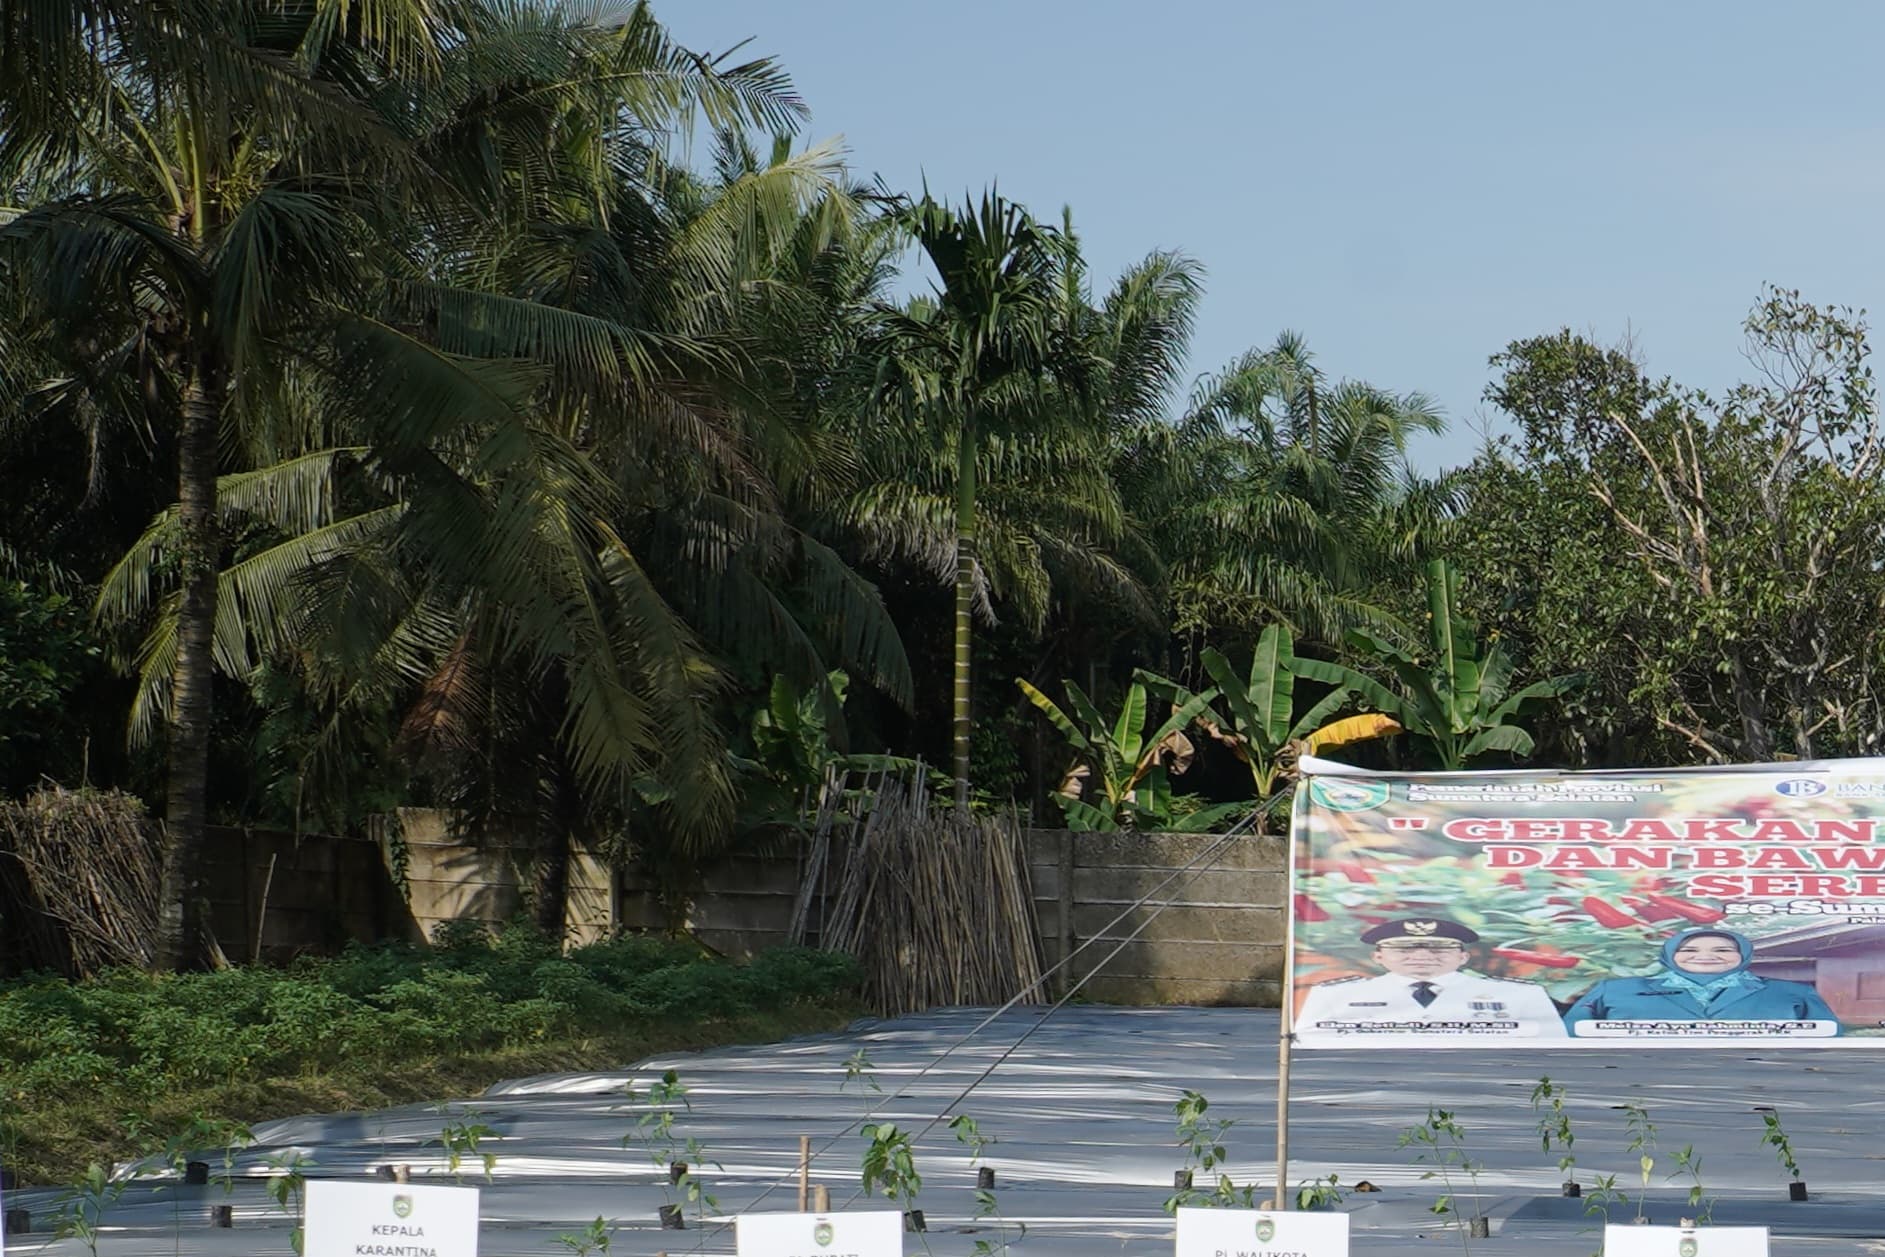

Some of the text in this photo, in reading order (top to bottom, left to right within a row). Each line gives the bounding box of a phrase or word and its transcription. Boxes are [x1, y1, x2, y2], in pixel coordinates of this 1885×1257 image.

[1407, 792, 1637, 802] Sumatera Selatan
[1445, 819, 1876, 842] GERAKAN
[1486, 846, 1673, 869] DAN
[371, 1223, 425, 1238] KEPALA
